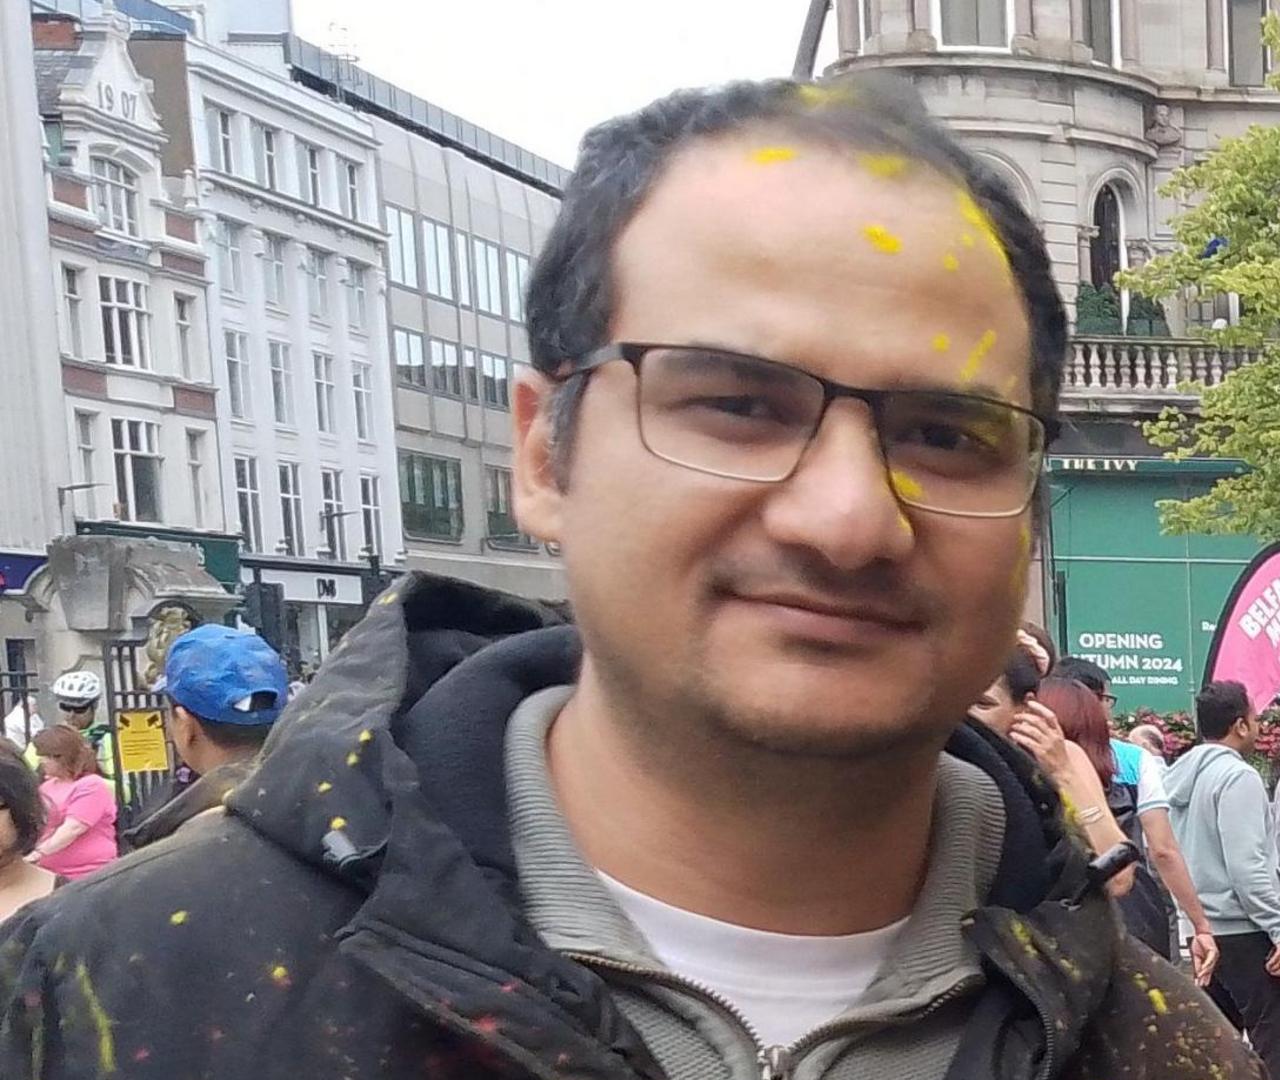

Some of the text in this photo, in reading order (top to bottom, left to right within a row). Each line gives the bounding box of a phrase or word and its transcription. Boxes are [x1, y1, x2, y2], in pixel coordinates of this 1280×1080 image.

[1103, 459, 1138, 471] IVY
[1079, 633, 1163, 649] OPENING
[1071, 655, 1183, 672] TUMN 2024
[1111, 675, 1128, 685] ALL
[1129, 676, 1146, 685] DAY
